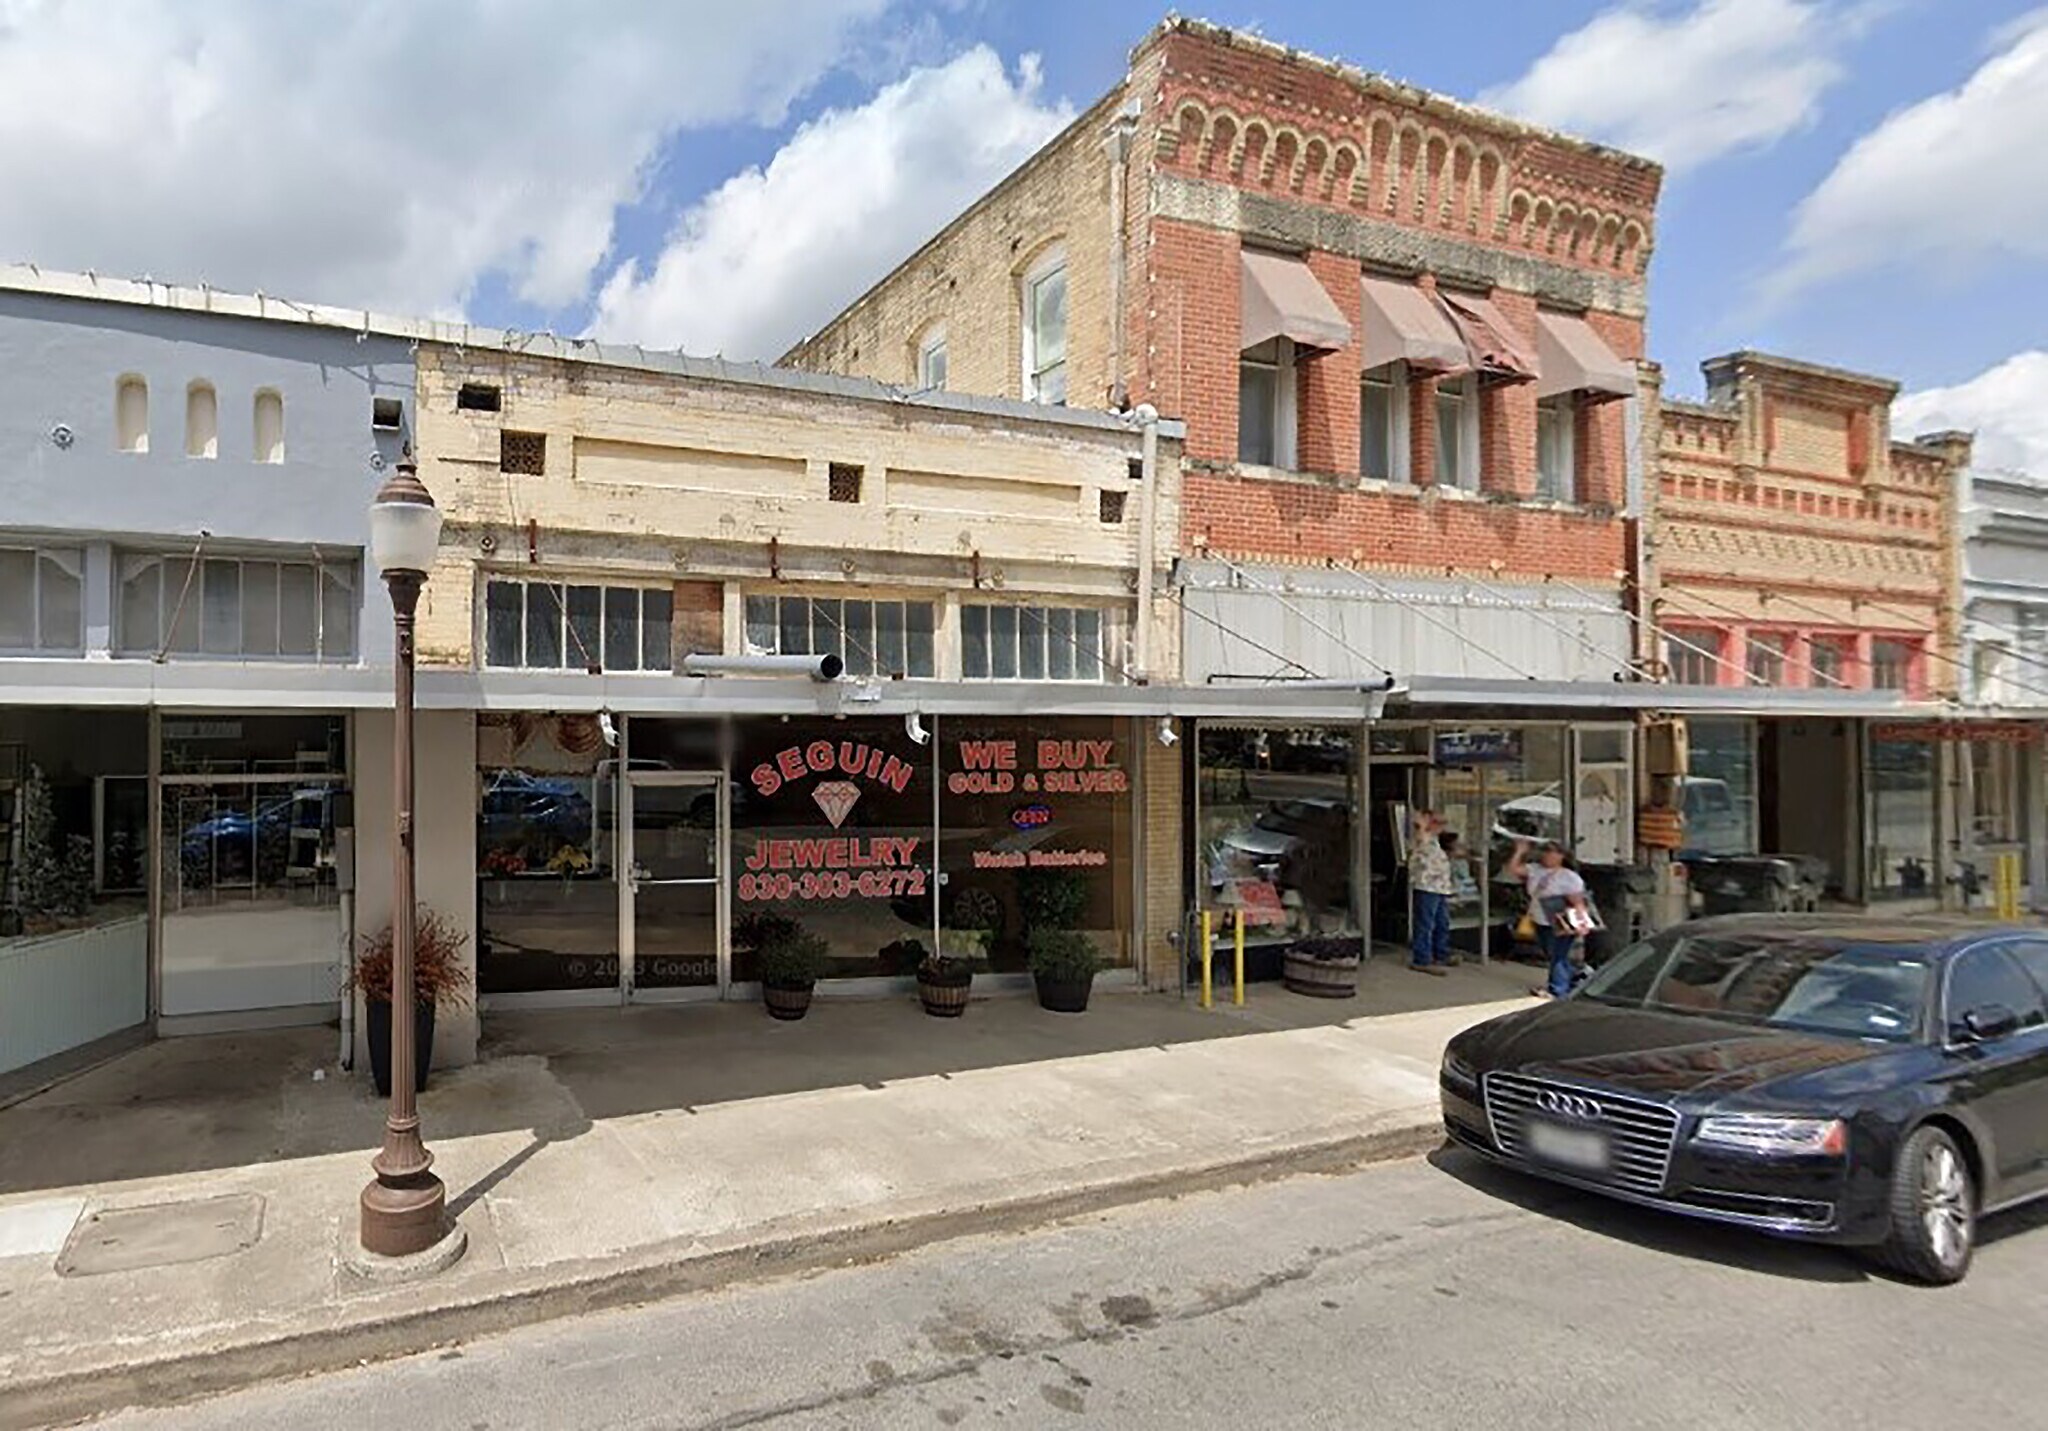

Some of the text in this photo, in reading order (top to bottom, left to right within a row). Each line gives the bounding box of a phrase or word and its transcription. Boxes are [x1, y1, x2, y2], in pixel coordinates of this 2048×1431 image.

[751, 739, 914, 796] SEGUIN
[960, 740, 1114, 770] WE BUY
[948, 769, 1128, 794] GOLD & SILVER
[744, 837, 920, 870] JEWELRY
[738, 868, 926, 900] 830-303-6272
